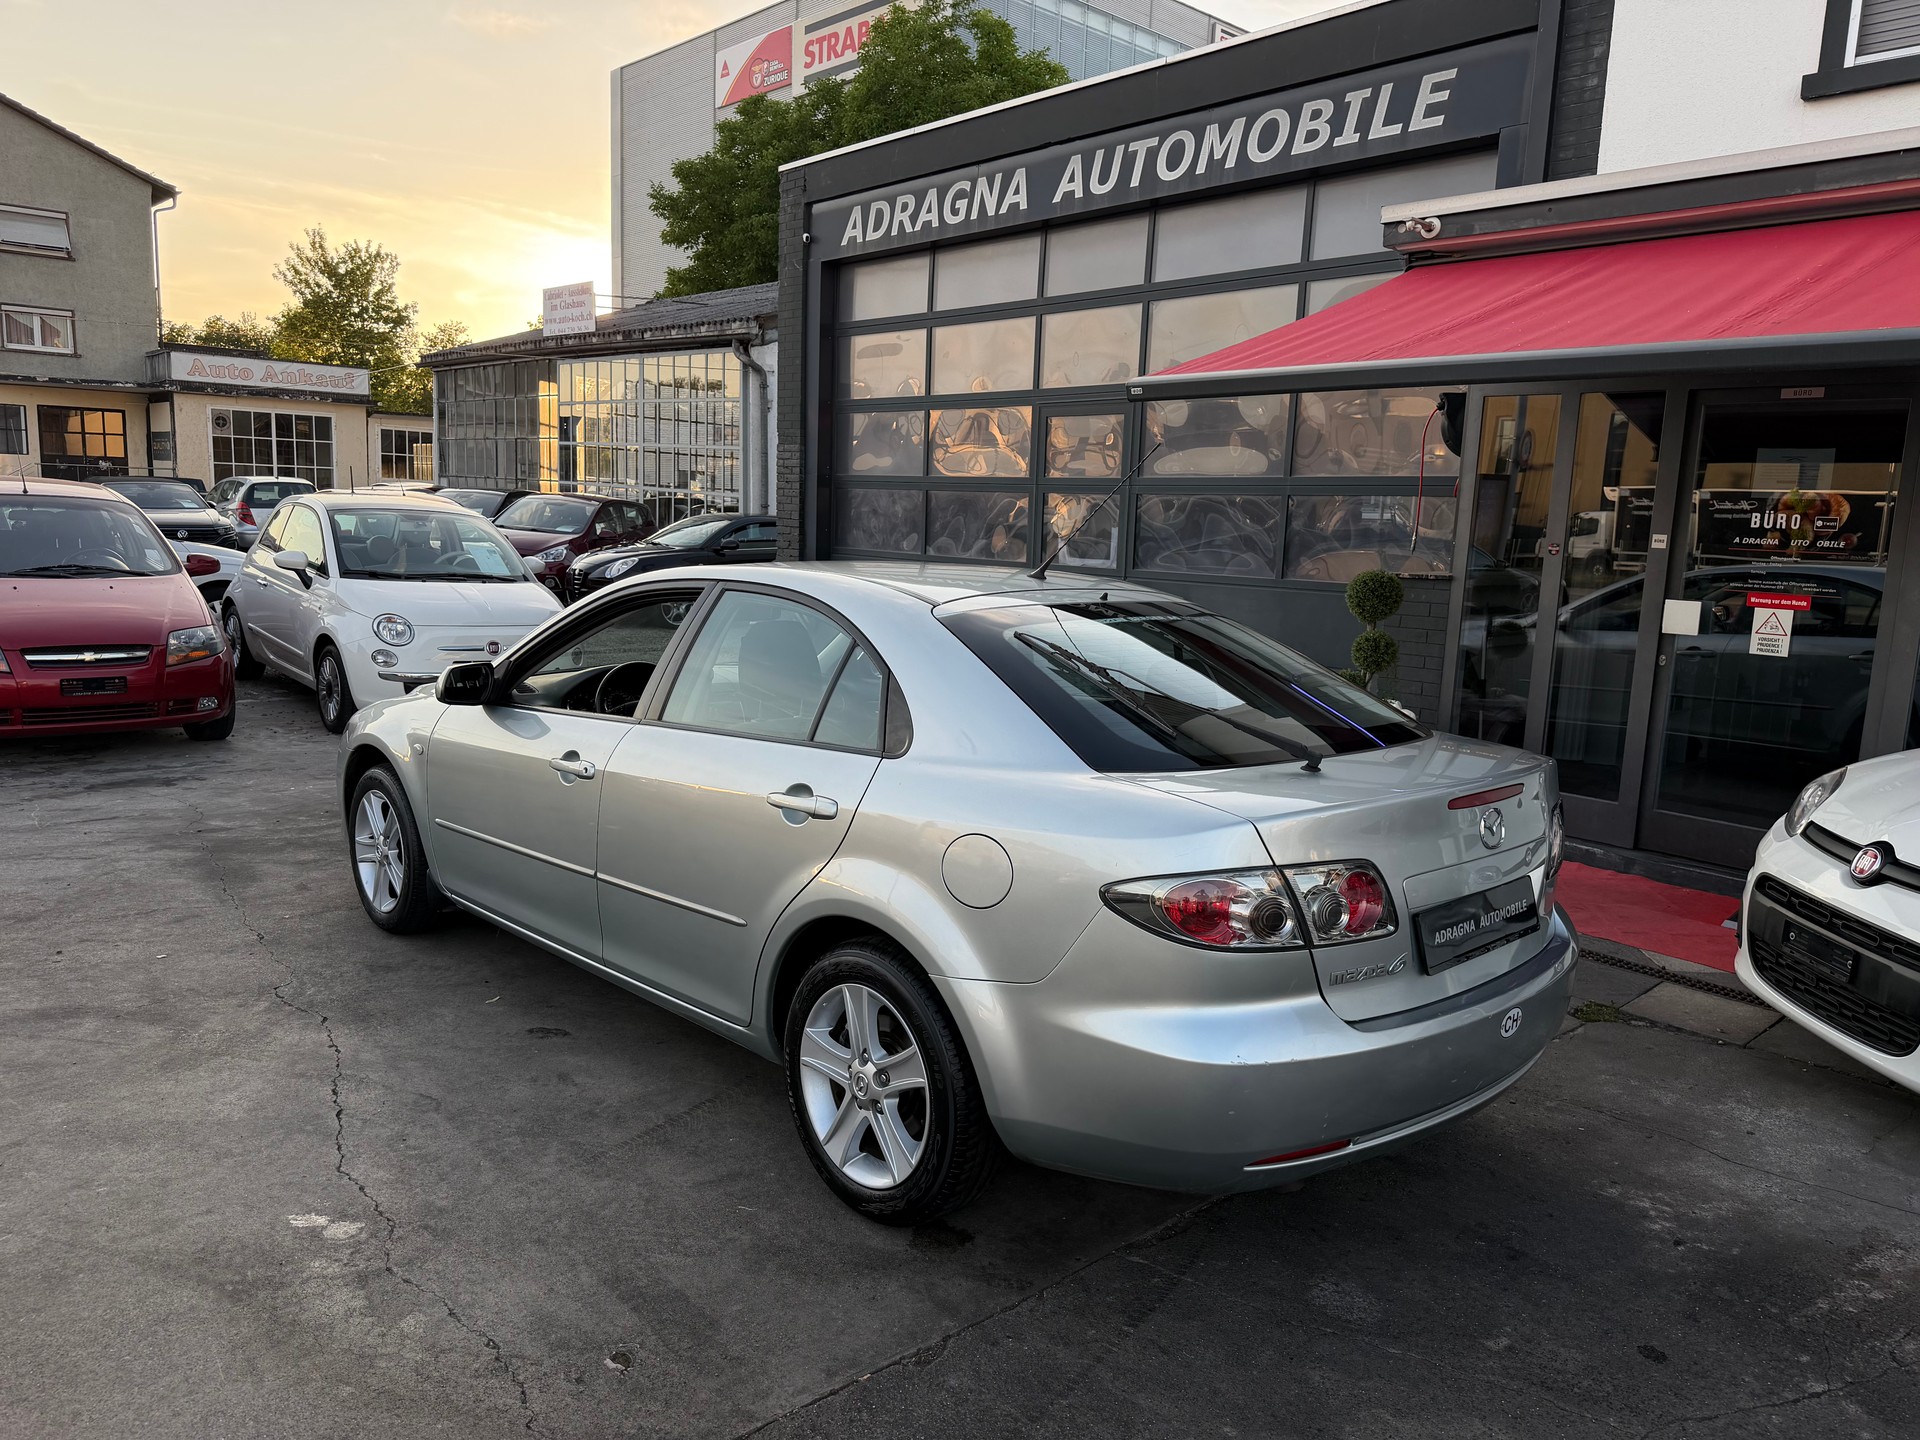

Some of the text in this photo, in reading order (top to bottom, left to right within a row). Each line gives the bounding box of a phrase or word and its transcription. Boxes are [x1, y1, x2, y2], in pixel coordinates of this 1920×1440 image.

[840, 67, 1460, 247] ADRAGNA AUTOMOBILE
[550, 299, 586, 311] im Glashaus
[187, 357, 355, 389] Auto Ankauf
[1750, 510, 1802, 530] BÜRO
[1750, 596, 1771, 605] Warnung
[1856, 854, 1877, 871] FIAT
[1434, 899, 1528, 945] ADRAGNA AUTOMOBILE
[1504, 1011, 1519, 1034] CH
